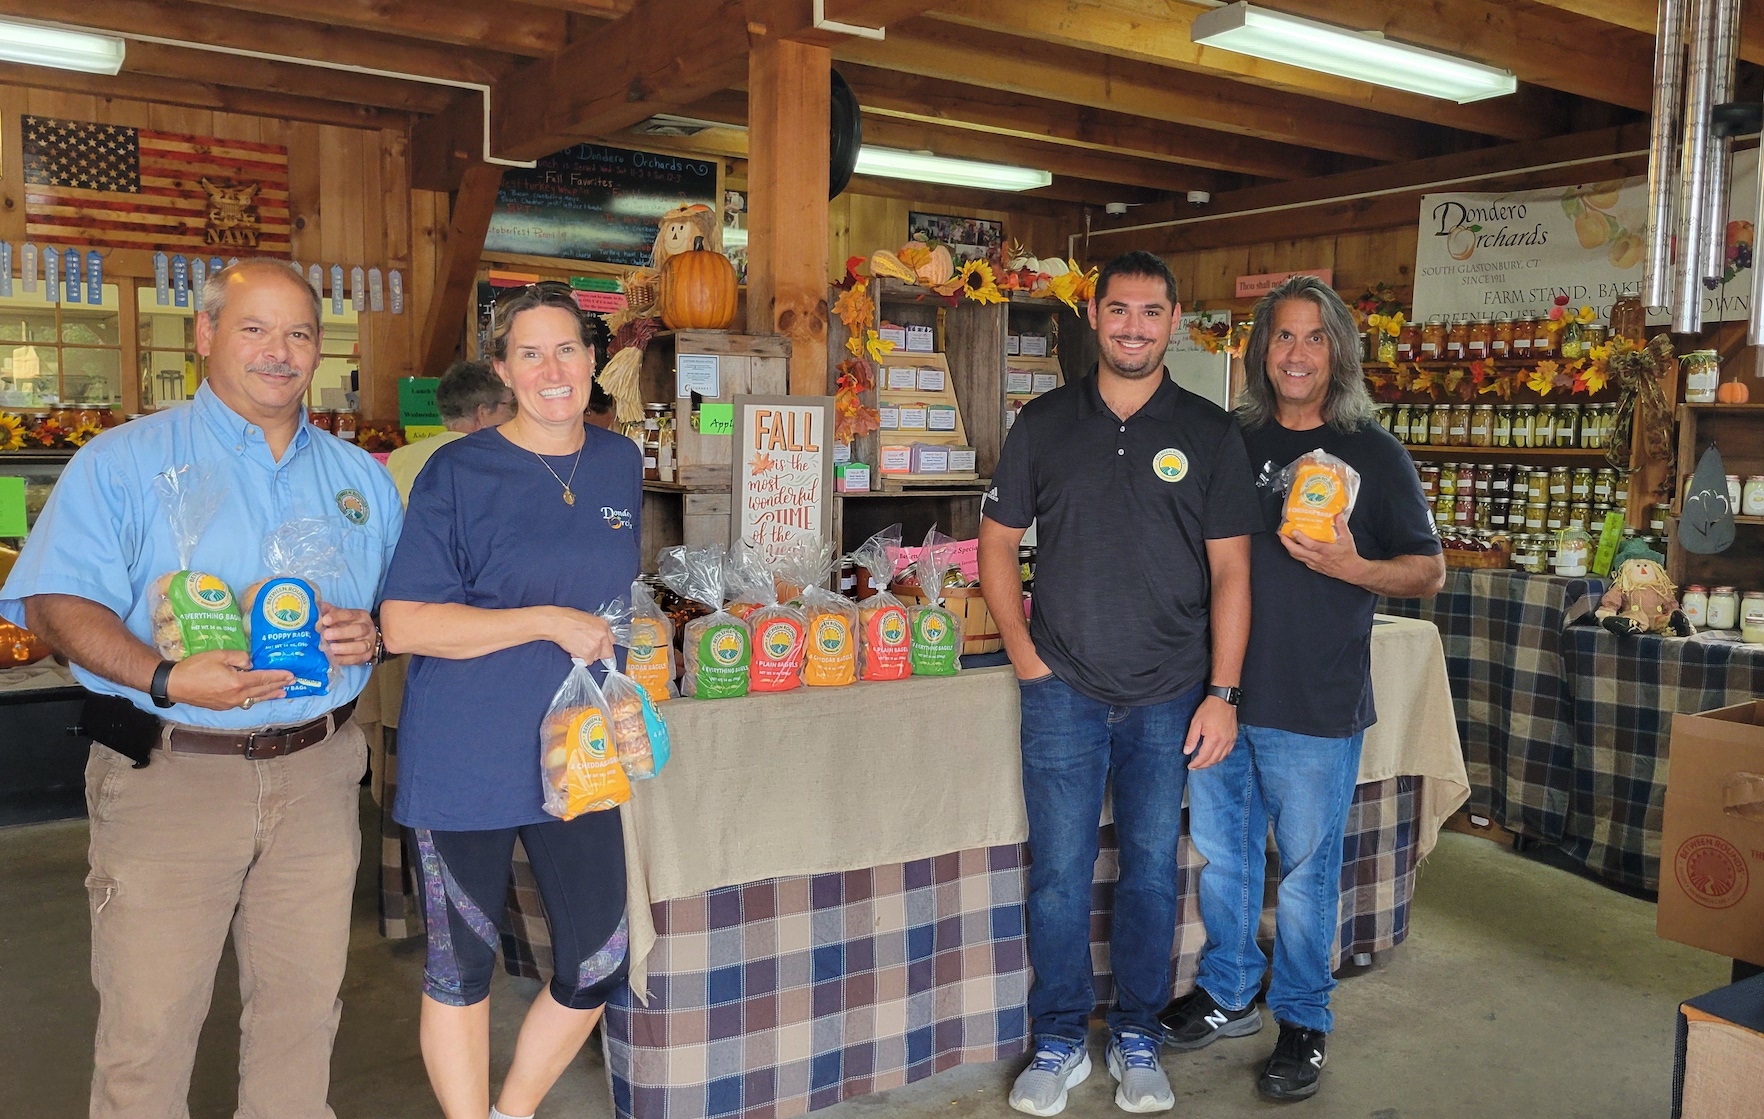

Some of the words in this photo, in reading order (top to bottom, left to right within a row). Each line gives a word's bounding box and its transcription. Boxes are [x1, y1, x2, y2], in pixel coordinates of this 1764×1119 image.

[577, 143, 624, 163] Dondero
[633, 152, 683, 171] Orchards
[570, 173, 613, 188] Favorites
[1433, 198, 1527, 236] Dondero
[207, 228, 259, 247] NAVY
[1422, 266, 1455, 276] SOUTH
[1458, 260, 1524, 274] GLASTONBURY,
[1526, 259, 1541, 268] CT
[1239, 282, 1255, 291] Thou
[1256, 280, 1270, 289] shall
[1461, 276, 1490, 285] SINCE
[1491, 274, 1506, 283] 1911
[1483, 290, 1523, 305] FARM
[710, 418, 734, 433] Appl
[756, 410, 819, 452] FALL
[775, 459, 786, 471] is
[788, 453, 810, 472] the
[748, 475, 780, 492] most
[748, 477, 819, 511] wonderful
[775, 506, 815, 530] TIME
[753, 522, 767, 545] of
[770, 525, 797, 542] the
[957, 545, 978, 555] Specia
[267, 587, 287, 605] BETWEEN
[288, 587, 307, 605] ROUNDS
[267, 632, 291, 641] POPPY
[758, 660, 777, 668] PLAIN
[1679, 838, 1713, 860] BETWEEN
[1714, 840, 1745, 874] ROUNDS
